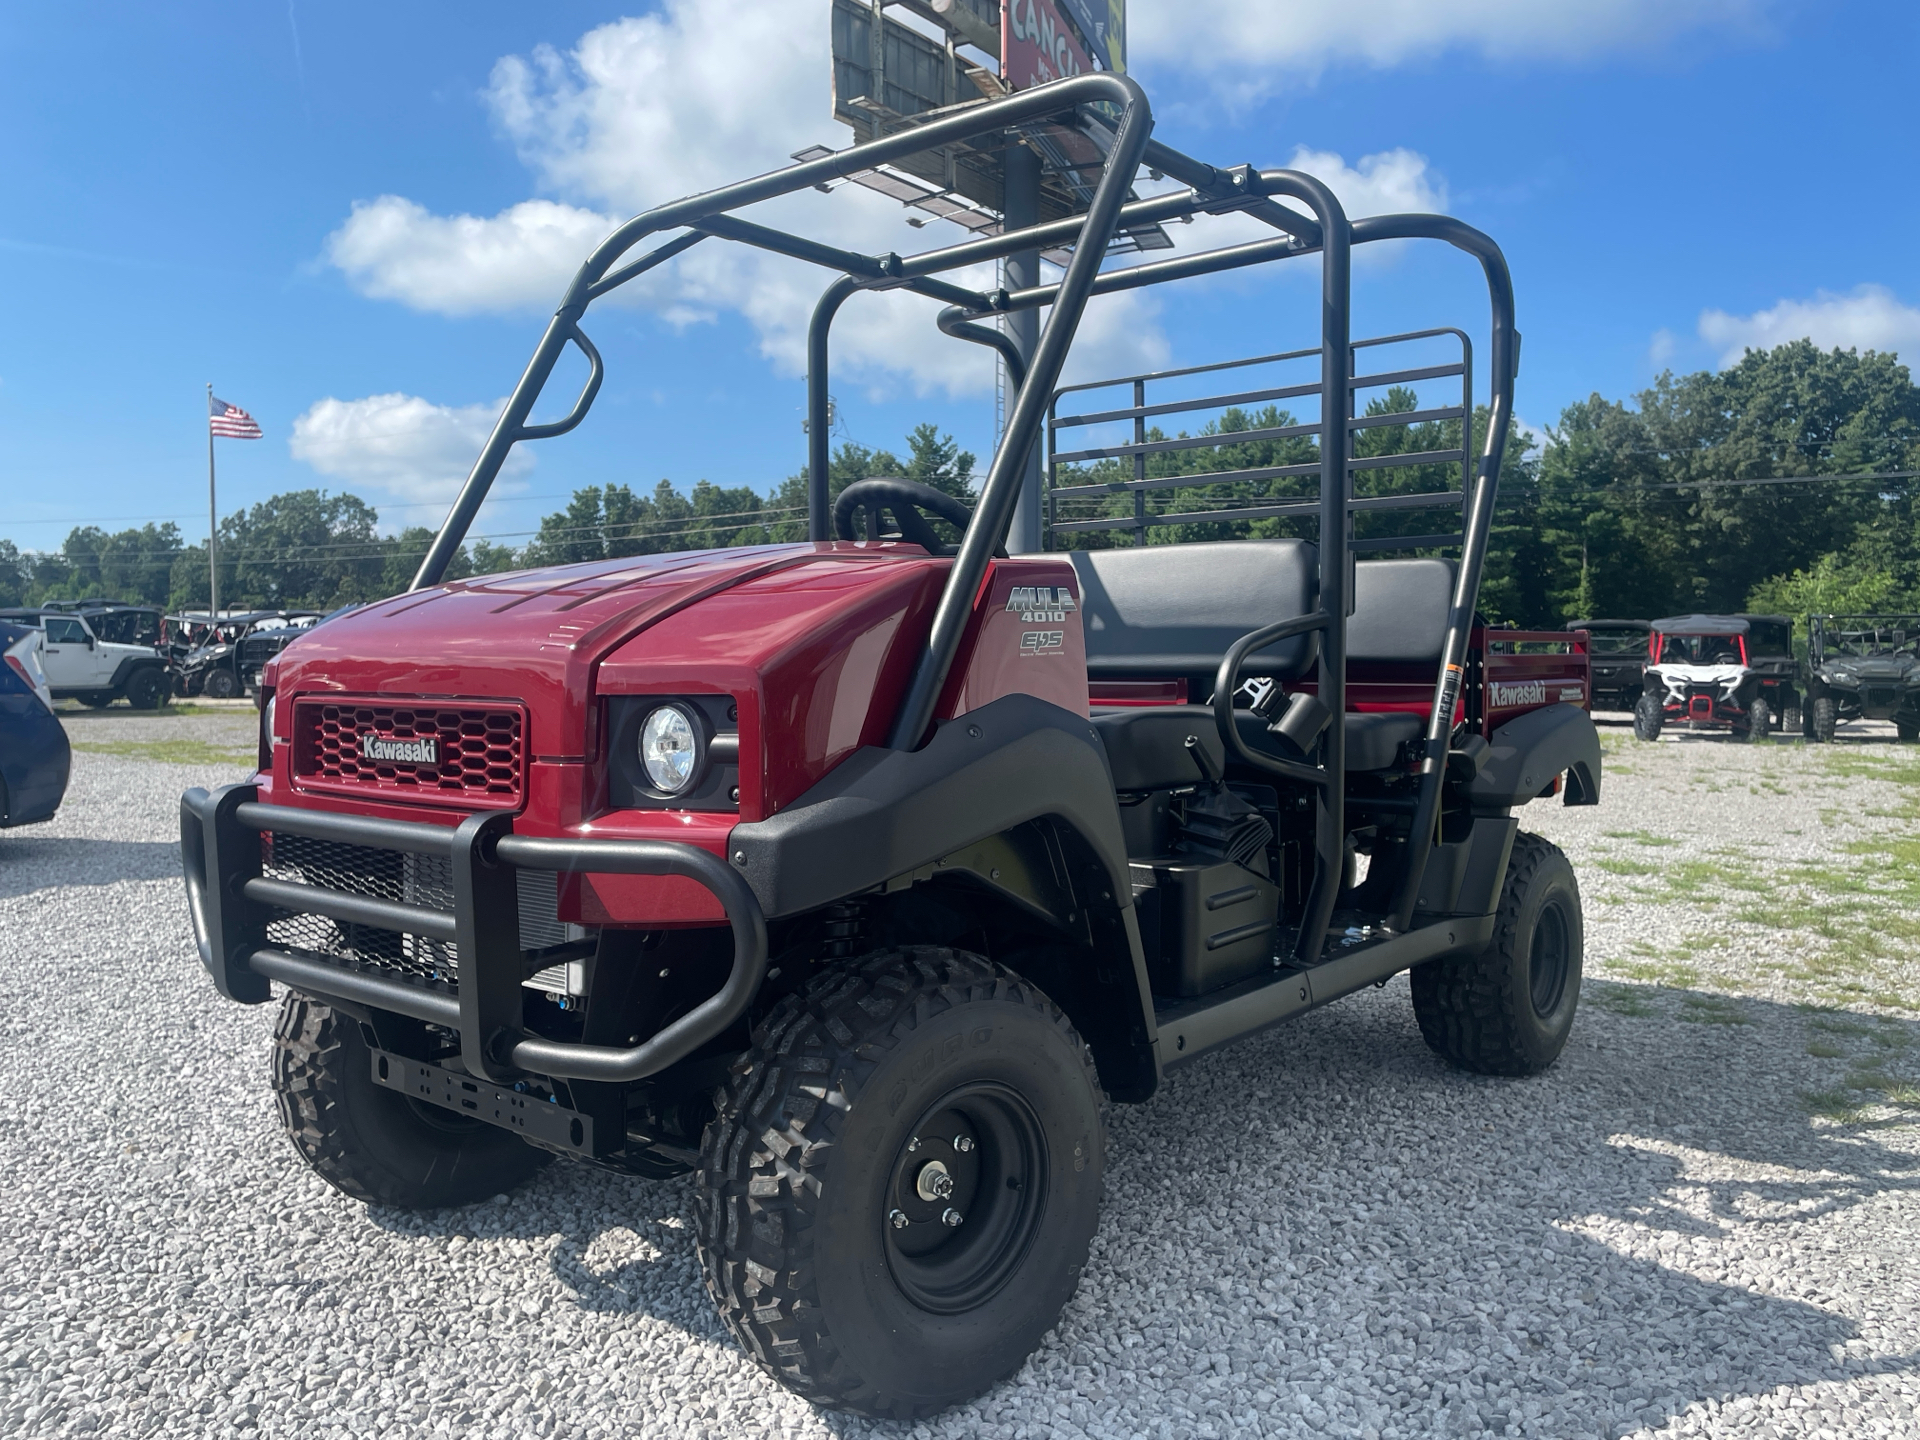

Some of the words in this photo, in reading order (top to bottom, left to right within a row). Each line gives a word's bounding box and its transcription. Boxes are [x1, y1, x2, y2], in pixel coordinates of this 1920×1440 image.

[1005, 587, 1078, 612] MULE
[1021, 611, 1066, 623] 4010
[1490, 680, 1547, 707] Kawasaki
[362, 735, 437, 763] Kawasaki
